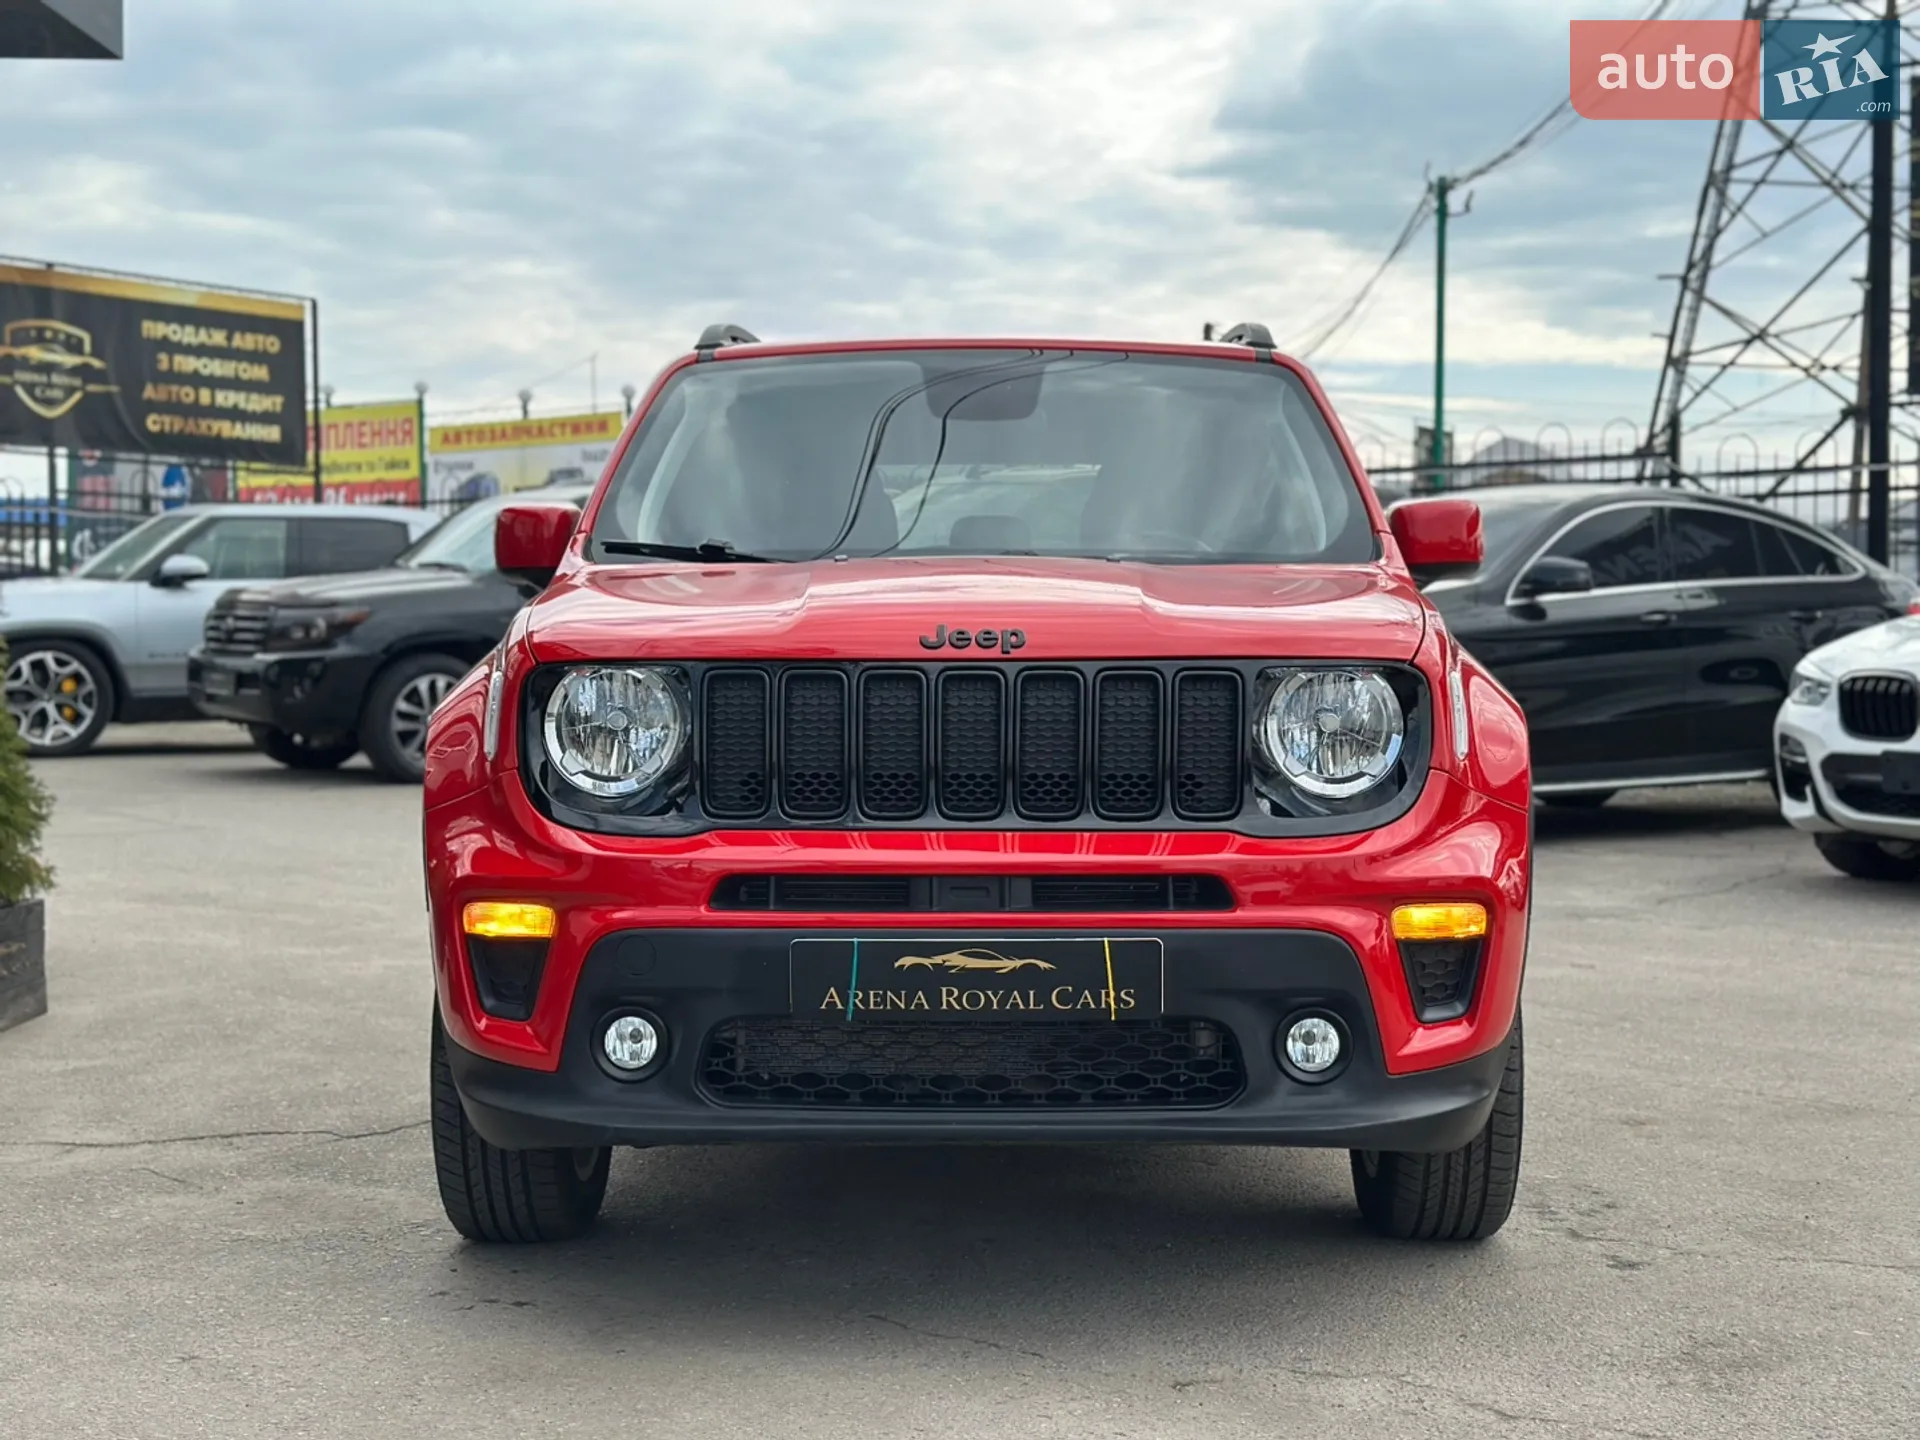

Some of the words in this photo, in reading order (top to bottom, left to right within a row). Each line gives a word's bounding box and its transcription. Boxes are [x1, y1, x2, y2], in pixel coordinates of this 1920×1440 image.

[141, 319, 229, 347] ПРОДАЖ
[231, 330, 282, 354] АВТО
[172, 353, 271, 383] ПРОБІГОМ
[142, 381, 197, 405] АВТО
[198, 386, 213, 407] В
[214, 387, 285, 414] КРЕДИТ
[145, 412, 282, 443] СТРАХУВАННЯ
[441, 419, 609, 446] АВТОЗАПЧАСТИНИ
[919, 624, 1026, 655] Jeep
[819, 986, 931, 1010] ARENA
[939, 986, 1044, 1011] ROYAL
[1050, 986, 1135, 1010] CARS
